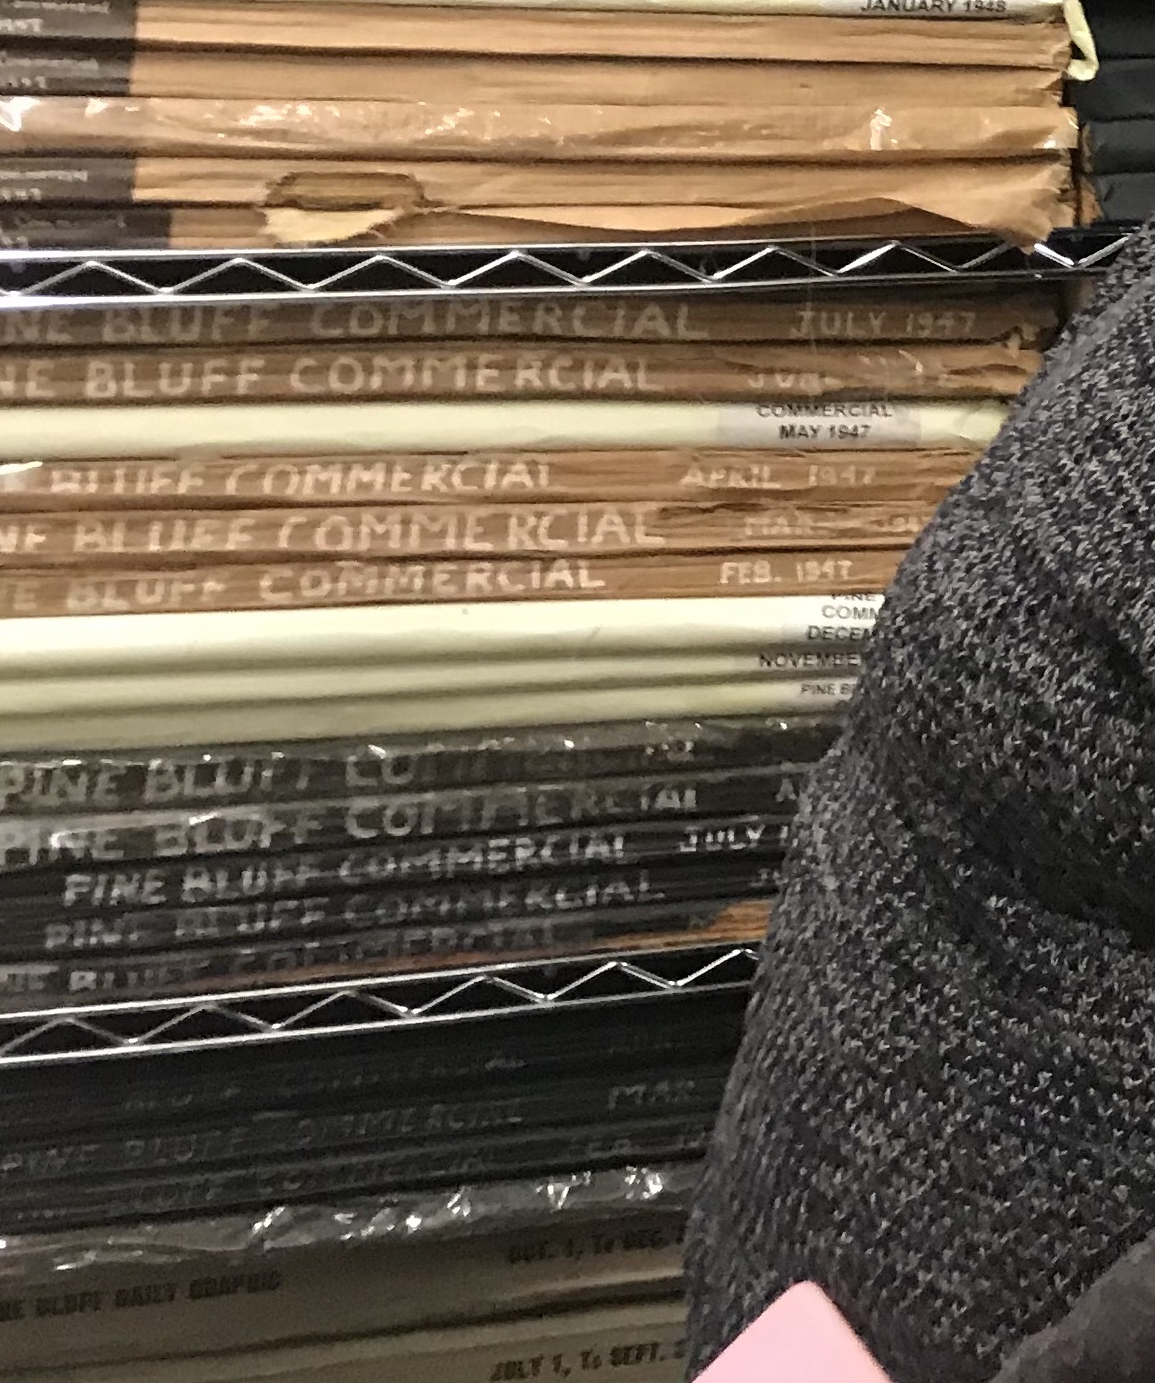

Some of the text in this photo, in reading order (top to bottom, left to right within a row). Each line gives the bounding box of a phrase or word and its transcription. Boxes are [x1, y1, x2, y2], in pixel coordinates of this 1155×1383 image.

[102, 306, 272, 342] BLUFF
[310, 301, 709, 339] COMMERCIAL
[789, 308, 886, 338] JULY
[84, 355, 665, 398] BLUFF COMMERCIAL
[756, 402, 893, 418] COMMERCIAL
[779, 424, 871, 439] MAY 1947
[680, 465, 782, 488] APRIL
[807, 464, 876, 487] 1947
[277, 508, 665, 551] COMMERCIAL
[259, 558, 606, 602] COMMERCIAL
[718, 560, 782, 584] FEB.
[801, 683, 836, 696] PINE
